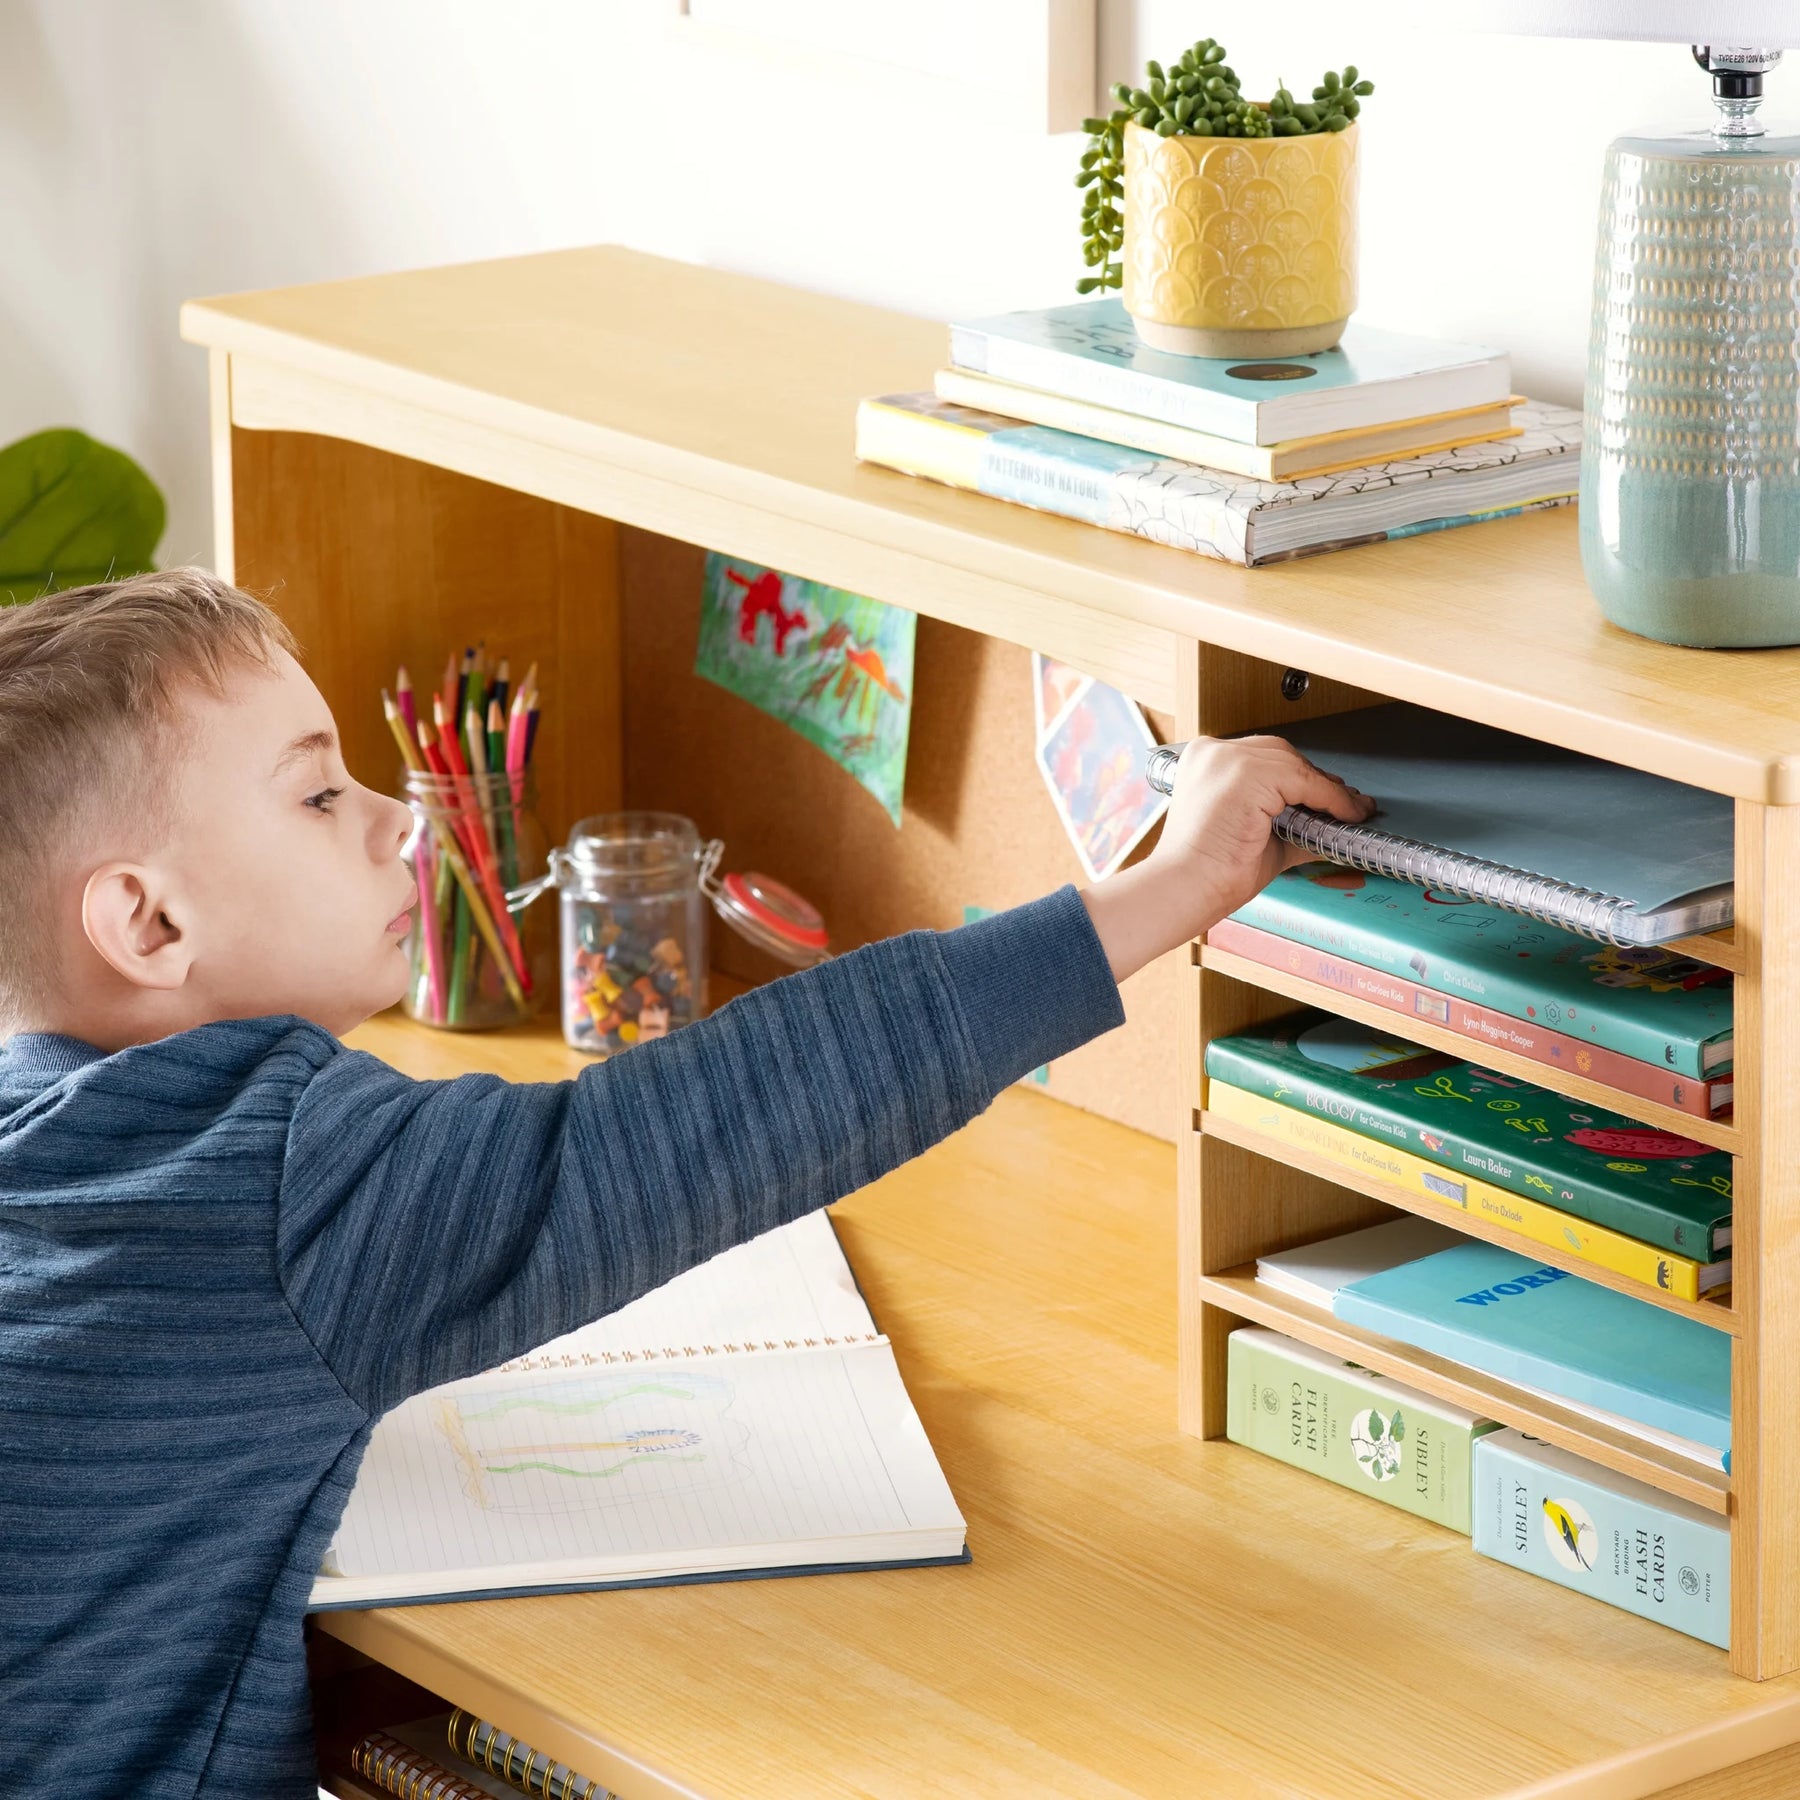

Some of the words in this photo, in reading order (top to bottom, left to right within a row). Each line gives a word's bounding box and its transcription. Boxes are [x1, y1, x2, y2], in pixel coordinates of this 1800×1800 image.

[1718, 54, 1733, 64] TYPE
[1734, 54, 1744, 64] E26
[1746, 54, 1758, 64] 120V
[988, 453, 1041, 485] PATTERNS
[1044, 468, 1056, 489] IN
[1058, 472, 1099, 500] NATURE
[1316, 962, 1354, 989] MATH
[1366, 980, 1390, 998] Curious
[1390, 988, 1405, 1003] Kids
[1443, 970, 1461, 986] Chris
[1463, 1014, 1480, 1030] Lynn
[1480, 1020, 1534, 1048] Huggins-Cooper
[1306, 1090, 1356, 1122] BIOLOGY
[1360, 1112, 1368, 1124] for
[1369, 1116, 1393, 1134] Curious
[1393, 1124, 1407, 1139] Kids
[1352, 1147, 1362, 1160] for
[1362, 1151, 1388, 1170] Curious
[1388, 1161, 1402, 1176] Kids
[1463, 1148, 1486, 1170] Laura
[1488, 1158, 1512, 1178] Baker
[1481, 1198, 1500, 1214] Chris
[1500, 1205, 1524, 1223] Oxlade
[1292, 1382, 1302, 1446] CARDS
[1306, 1389, 1317, 1451] FLASH
[1416, 1427, 1428, 1500] SIBLEY
[1515, 1480, 1528, 1554] SIBLEY
[1636, 1528, 1648, 1596] FLASH
[1652, 1534, 1665, 1603] CARDS
